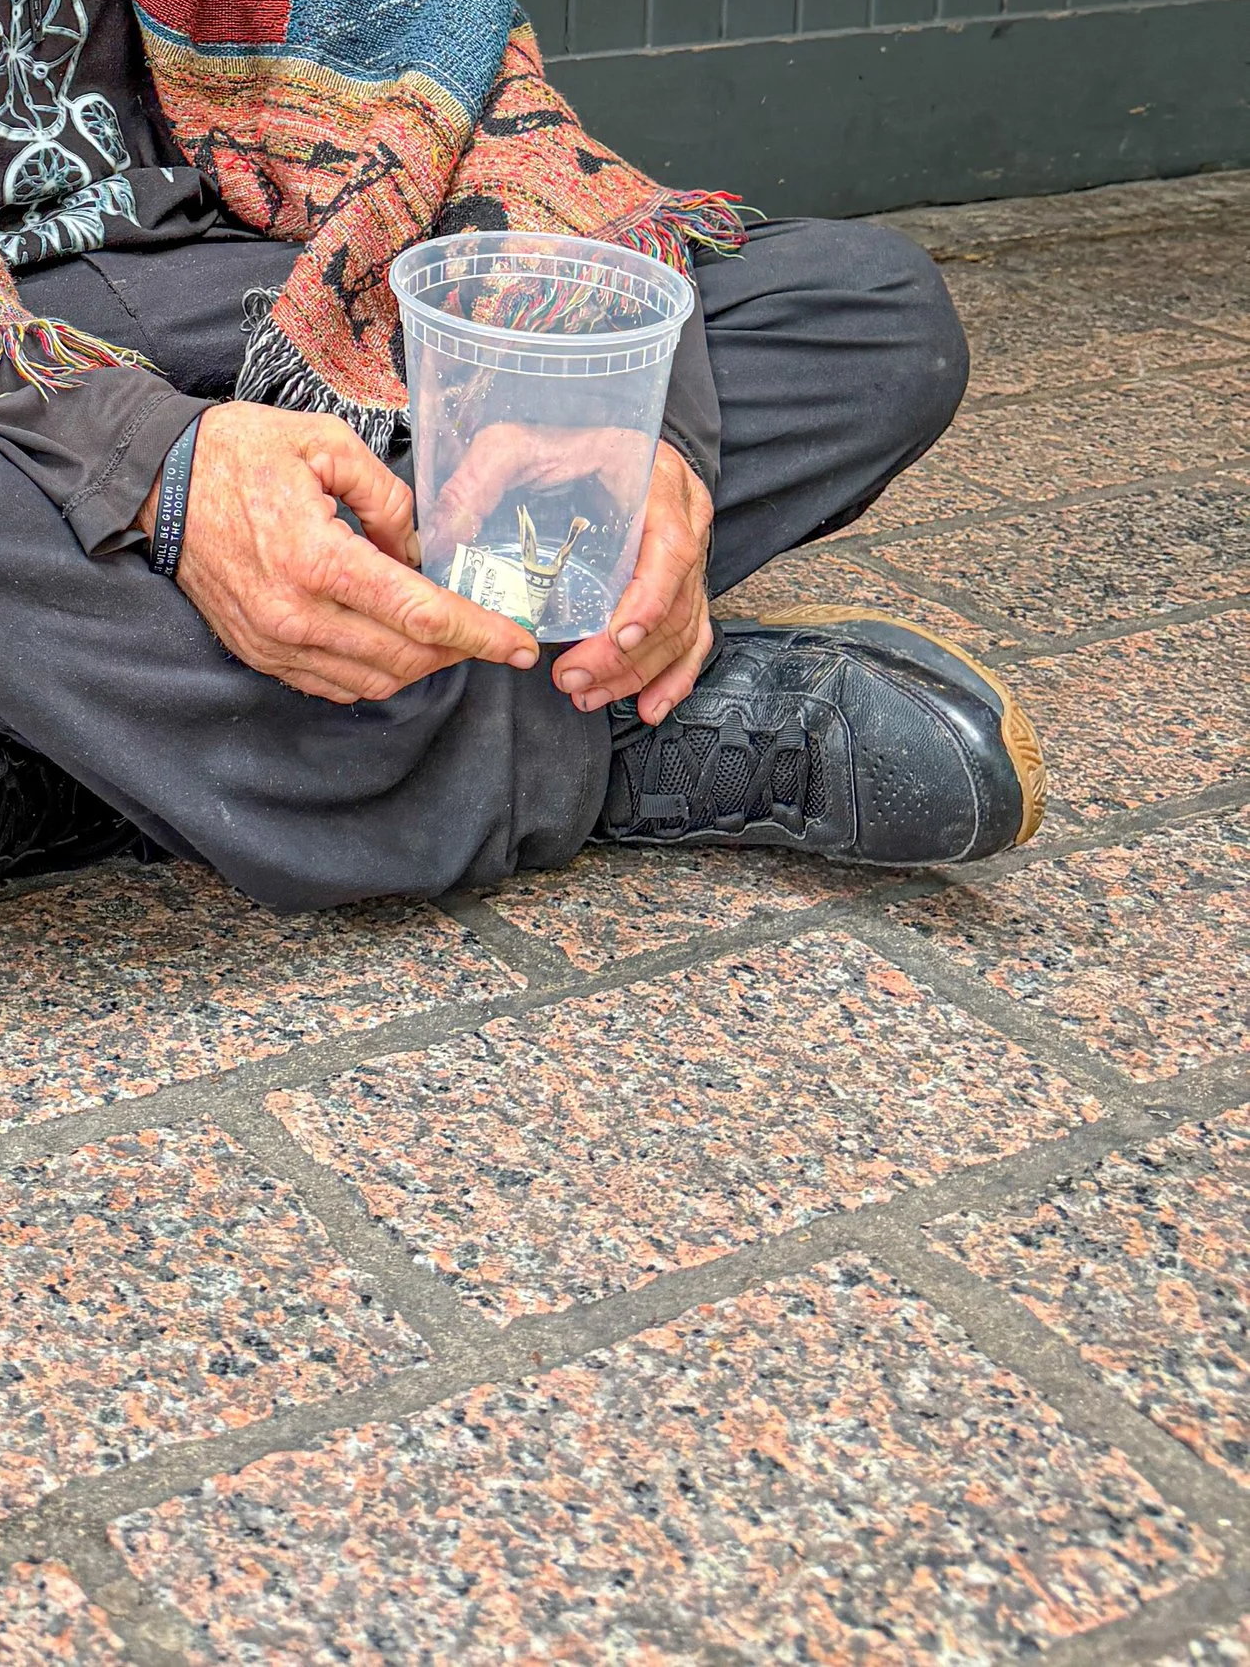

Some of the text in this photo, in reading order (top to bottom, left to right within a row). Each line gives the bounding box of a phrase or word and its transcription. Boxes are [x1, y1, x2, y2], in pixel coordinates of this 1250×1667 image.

[169, 441, 180, 463] YOU
[166, 467, 177, 481] TO
[162, 485, 174, 521] GIVEN
[160, 525, 170, 539] BE
[170, 521, 181, 541] THE
[167, 544, 178, 565] AND
